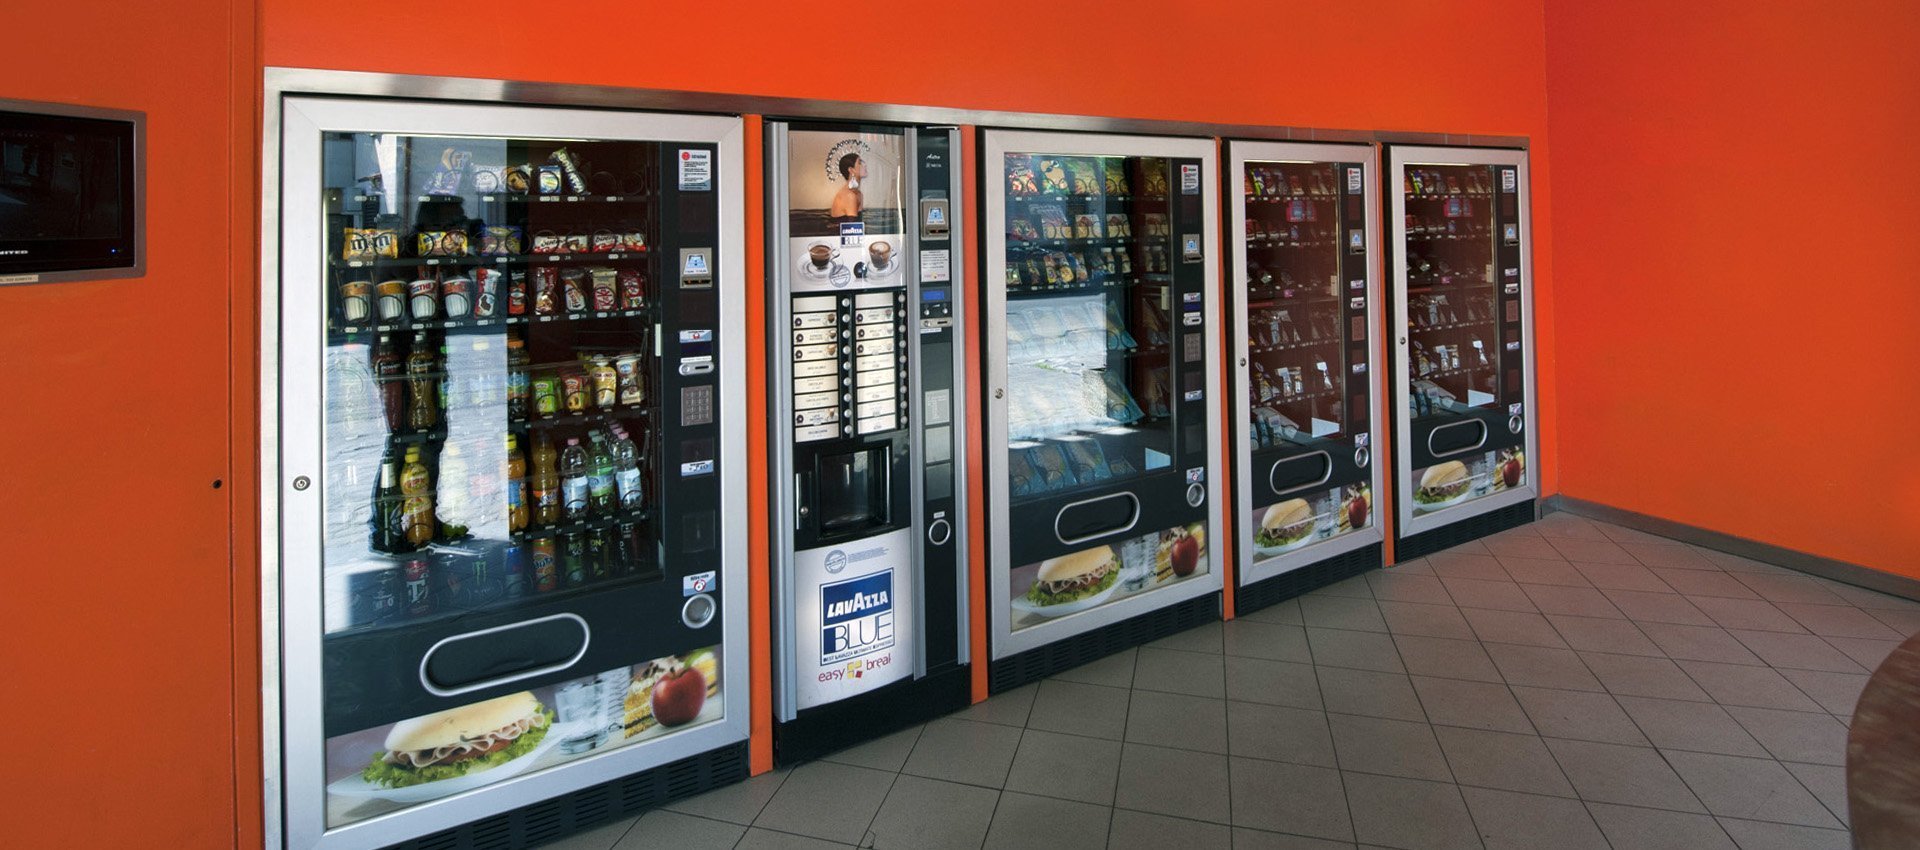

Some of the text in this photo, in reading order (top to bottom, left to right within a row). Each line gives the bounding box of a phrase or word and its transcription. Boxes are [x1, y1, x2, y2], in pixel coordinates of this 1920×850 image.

[827, 590, 889, 619] LAVAZZA
[823, 611, 892, 656] BLUE
[818, 668, 846, 682] easy
